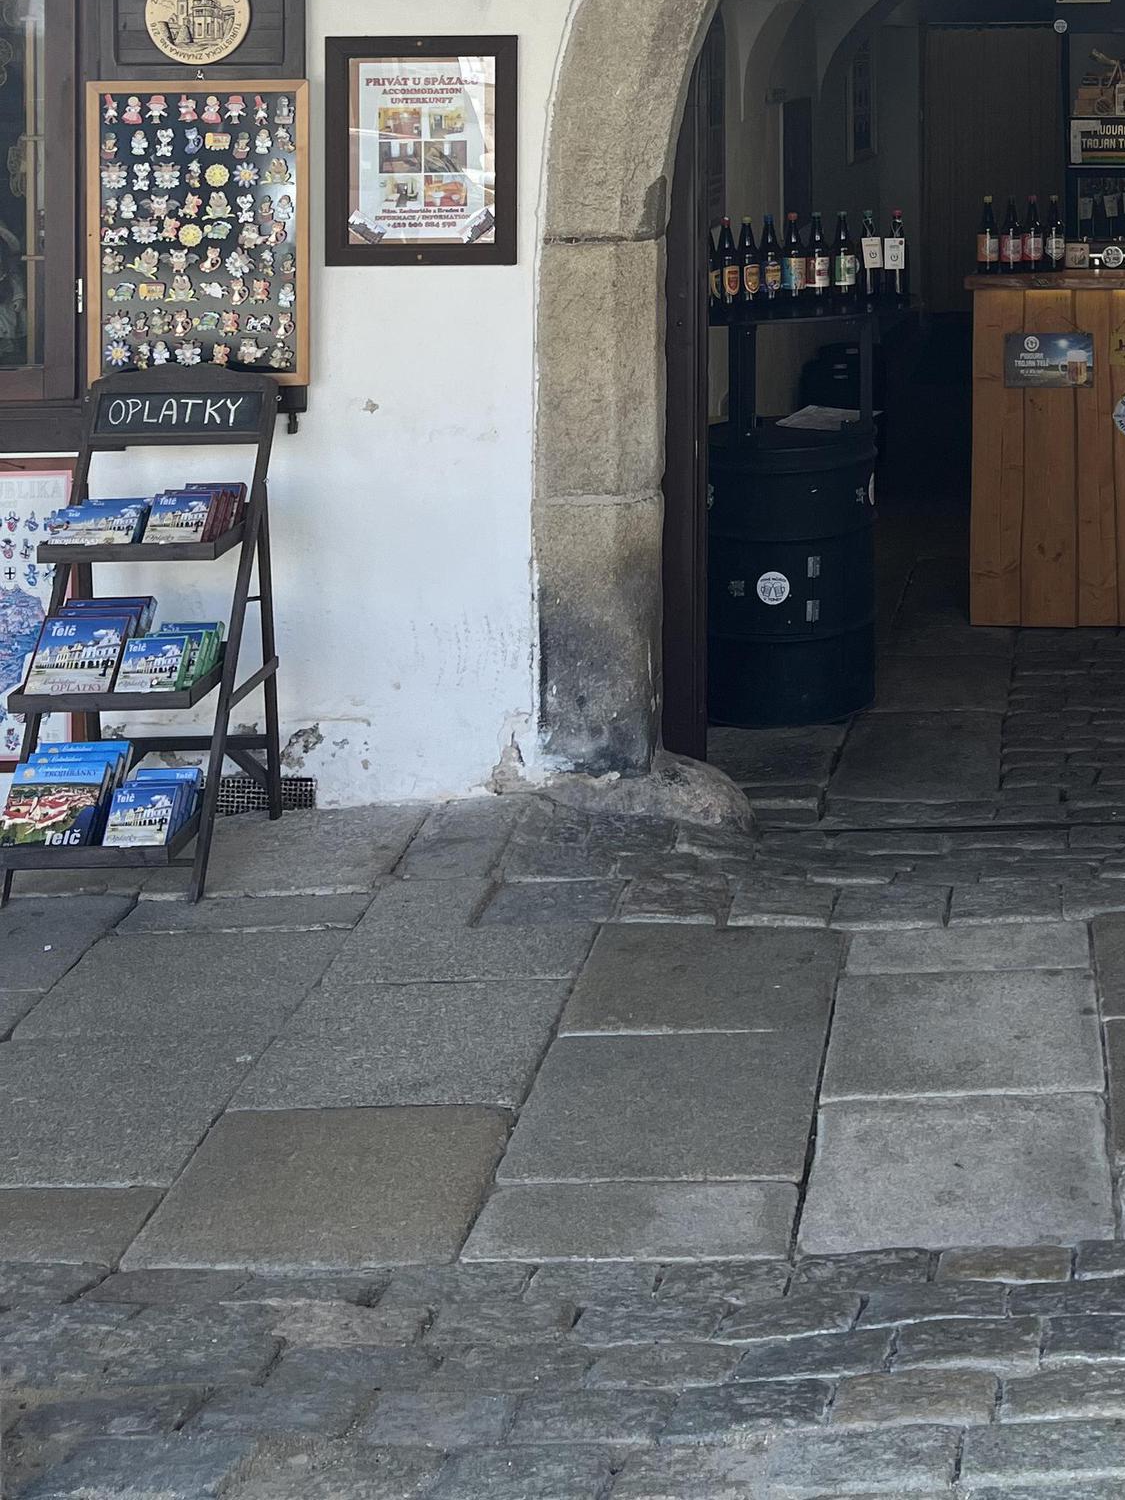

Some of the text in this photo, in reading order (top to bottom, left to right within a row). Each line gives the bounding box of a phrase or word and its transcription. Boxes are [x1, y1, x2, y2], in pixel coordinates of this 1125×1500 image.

[365, 76, 410, 87] PRIVÁT
[412, 78, 421, 86] U
[381, 87, 462, 95] ACCOMMODATION
[1081, 138, 1116, 149] TROJAN
[107, 396, 244, 427] OPLATKY
[0, 480, 63, 499] BLIKA
[51, 624, 77, 637] Telč
[128, 642, 147, 652] Telč
[51, 682, 102, 692] OPLATKY
[117, 792, 135, 803] Telč
[44, 829, 81, 846] Telč
